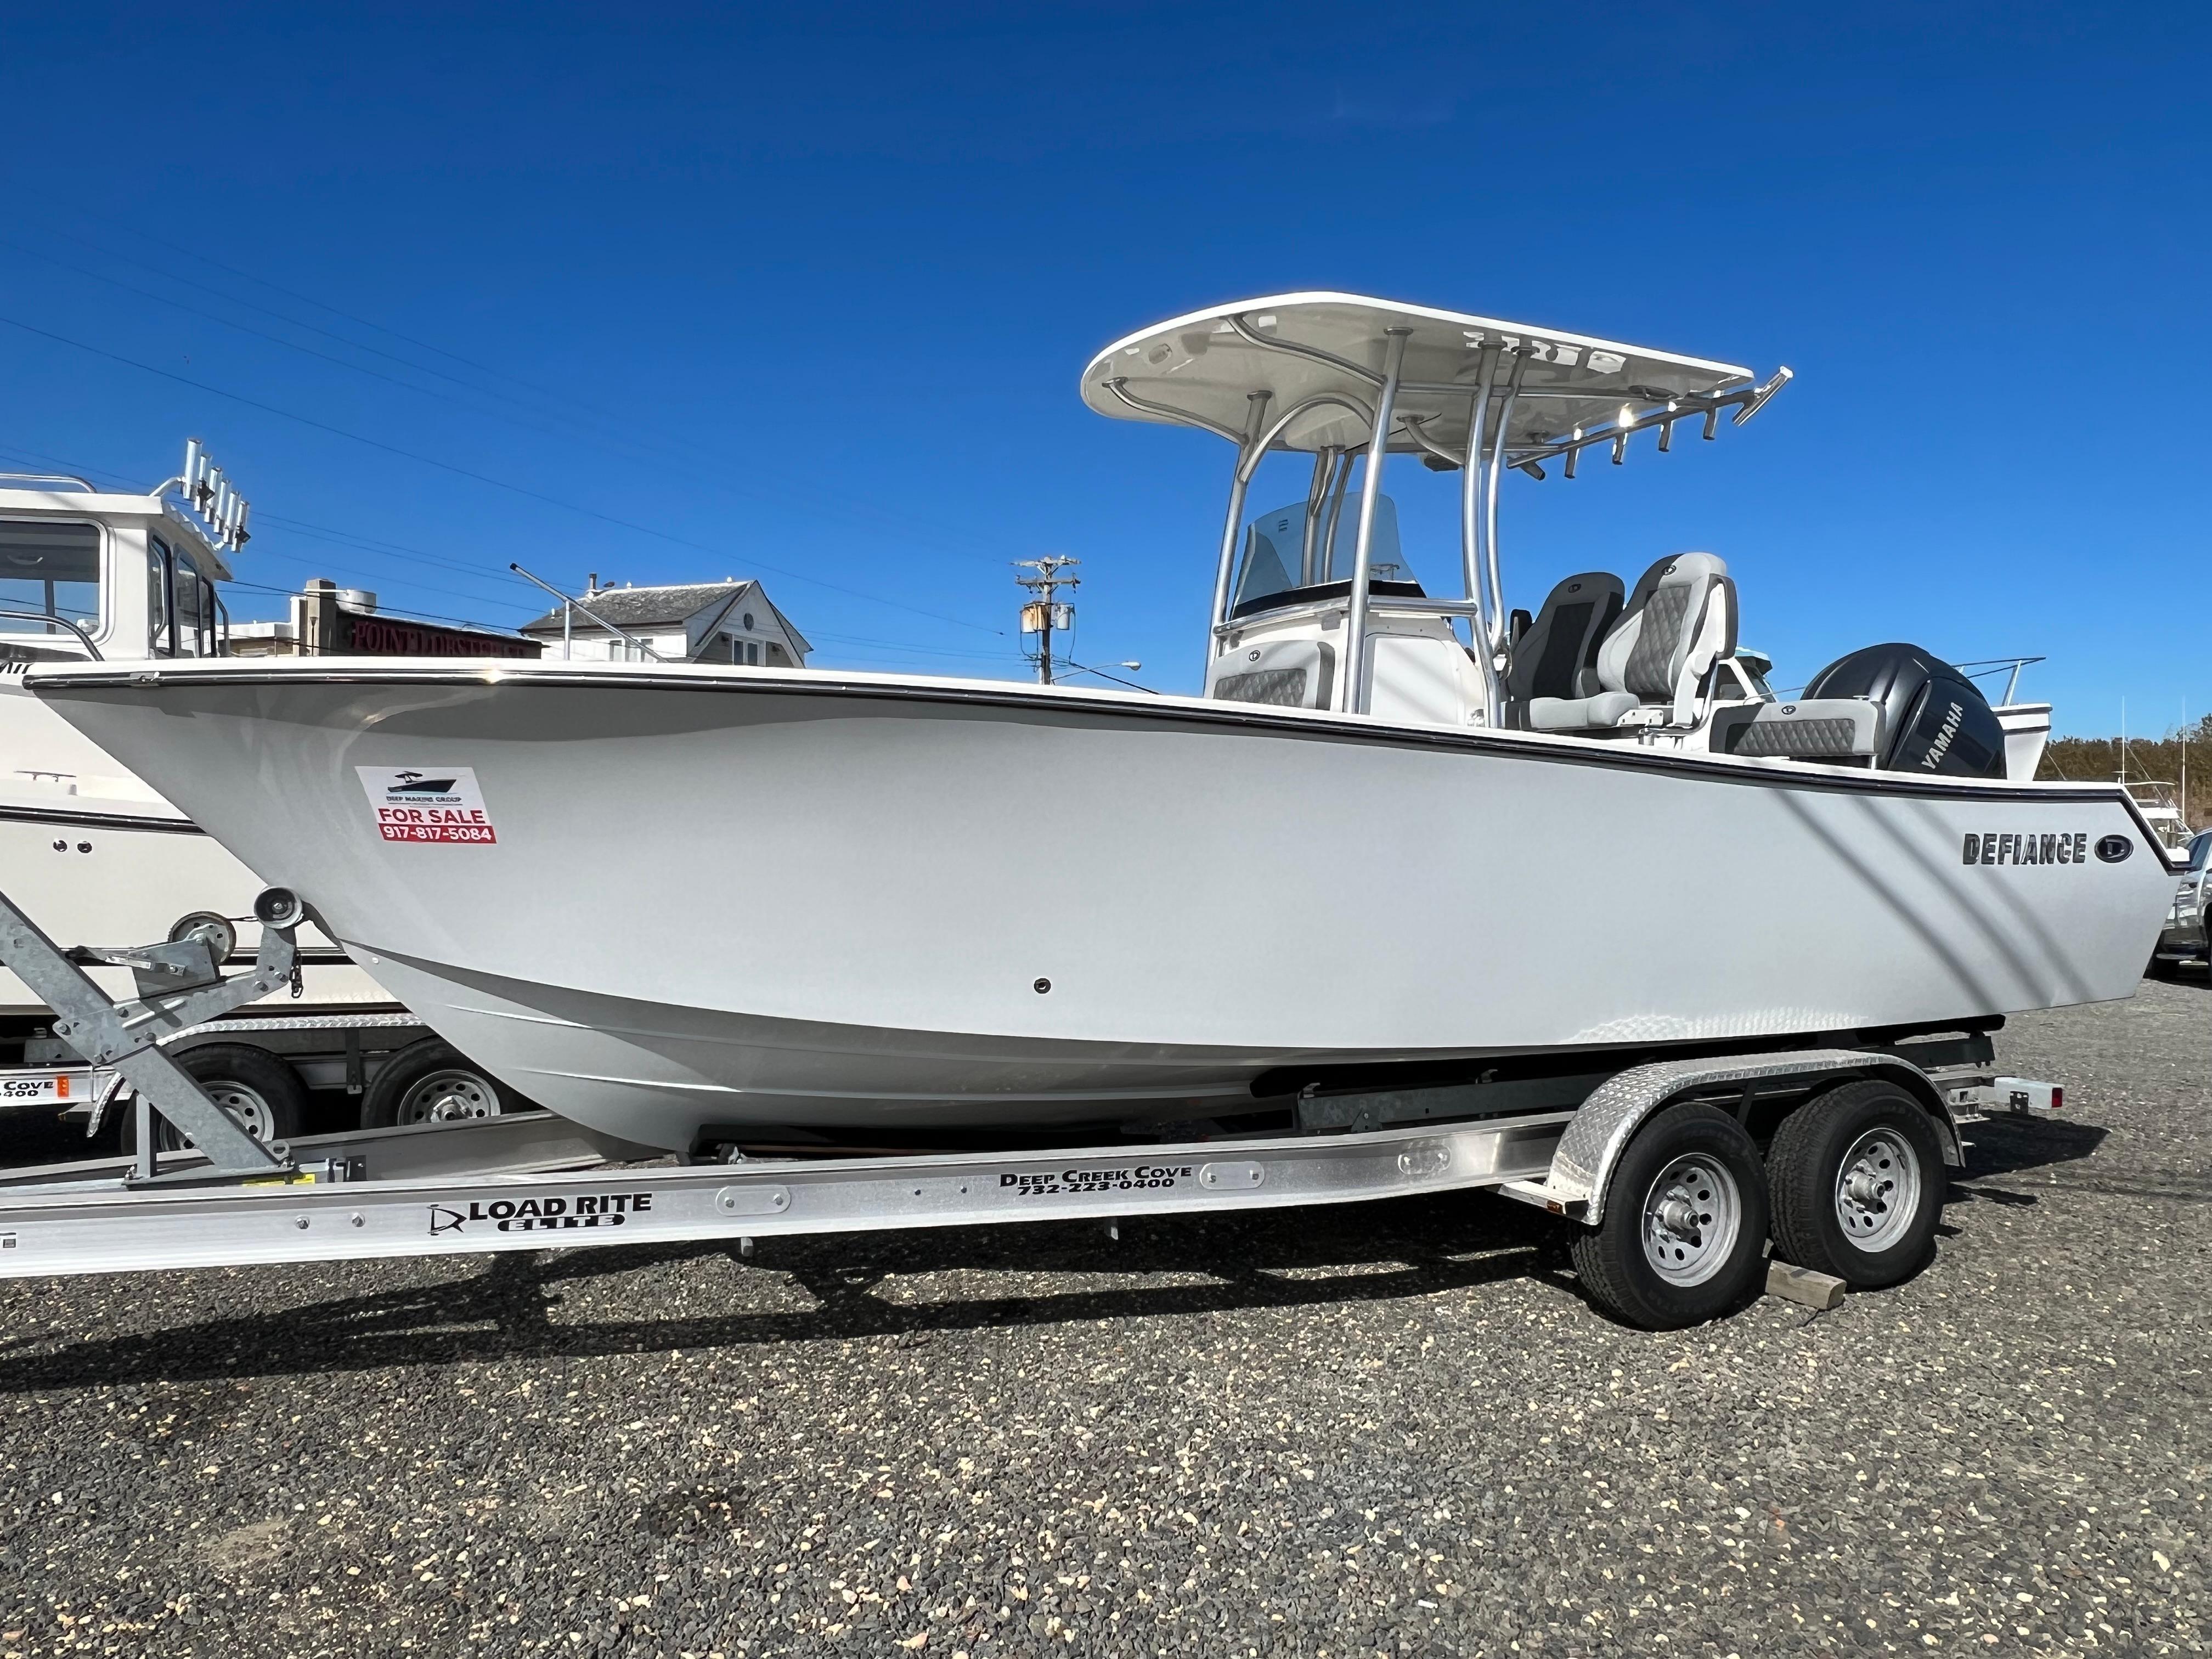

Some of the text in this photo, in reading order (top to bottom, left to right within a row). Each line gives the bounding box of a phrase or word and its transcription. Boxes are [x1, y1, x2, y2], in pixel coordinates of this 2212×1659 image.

[1921, 702, 1963, 769] YAMAHA
[377, 808, 486, 824] FOR SALE
[383, 826, 492, 840] 917-817-5084
[1962, 833, 2087, 865] DEFIANCE
[1000, 1166, 1192, 1188] DEEP CREEK COVE
[1017, 1178, 1175, 1196] 732-223-0400
[469, 1193, 652, 1221] LOAD RITE
[507, 1214, 616, 1231] ELITE
